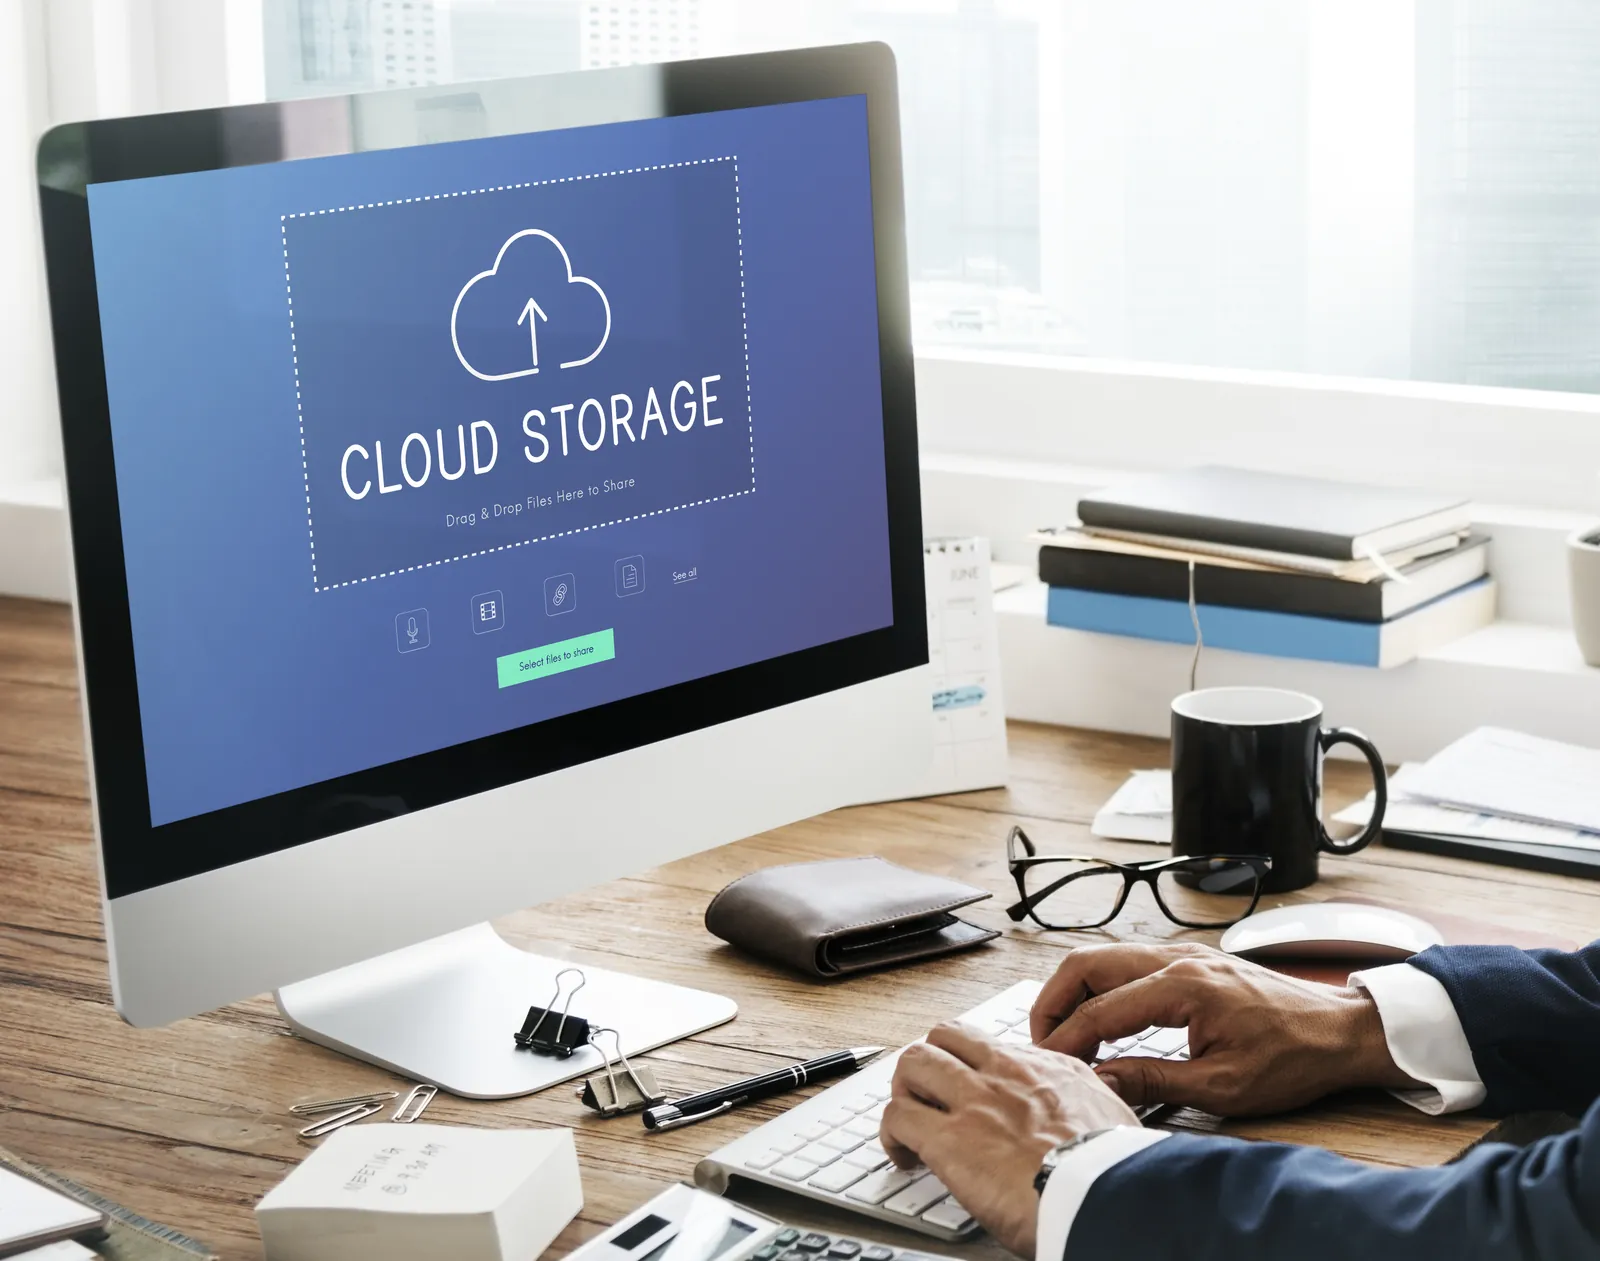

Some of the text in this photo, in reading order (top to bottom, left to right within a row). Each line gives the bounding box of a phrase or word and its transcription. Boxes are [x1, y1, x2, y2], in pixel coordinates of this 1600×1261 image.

[341, 374, 724, 500] CLOUD STORAGE
[446, 478, 635, 527] Drag & Drop Files Here to Share
[672, 567, 697, 581] See all
[519, 645, 594, 671] Select files to share
